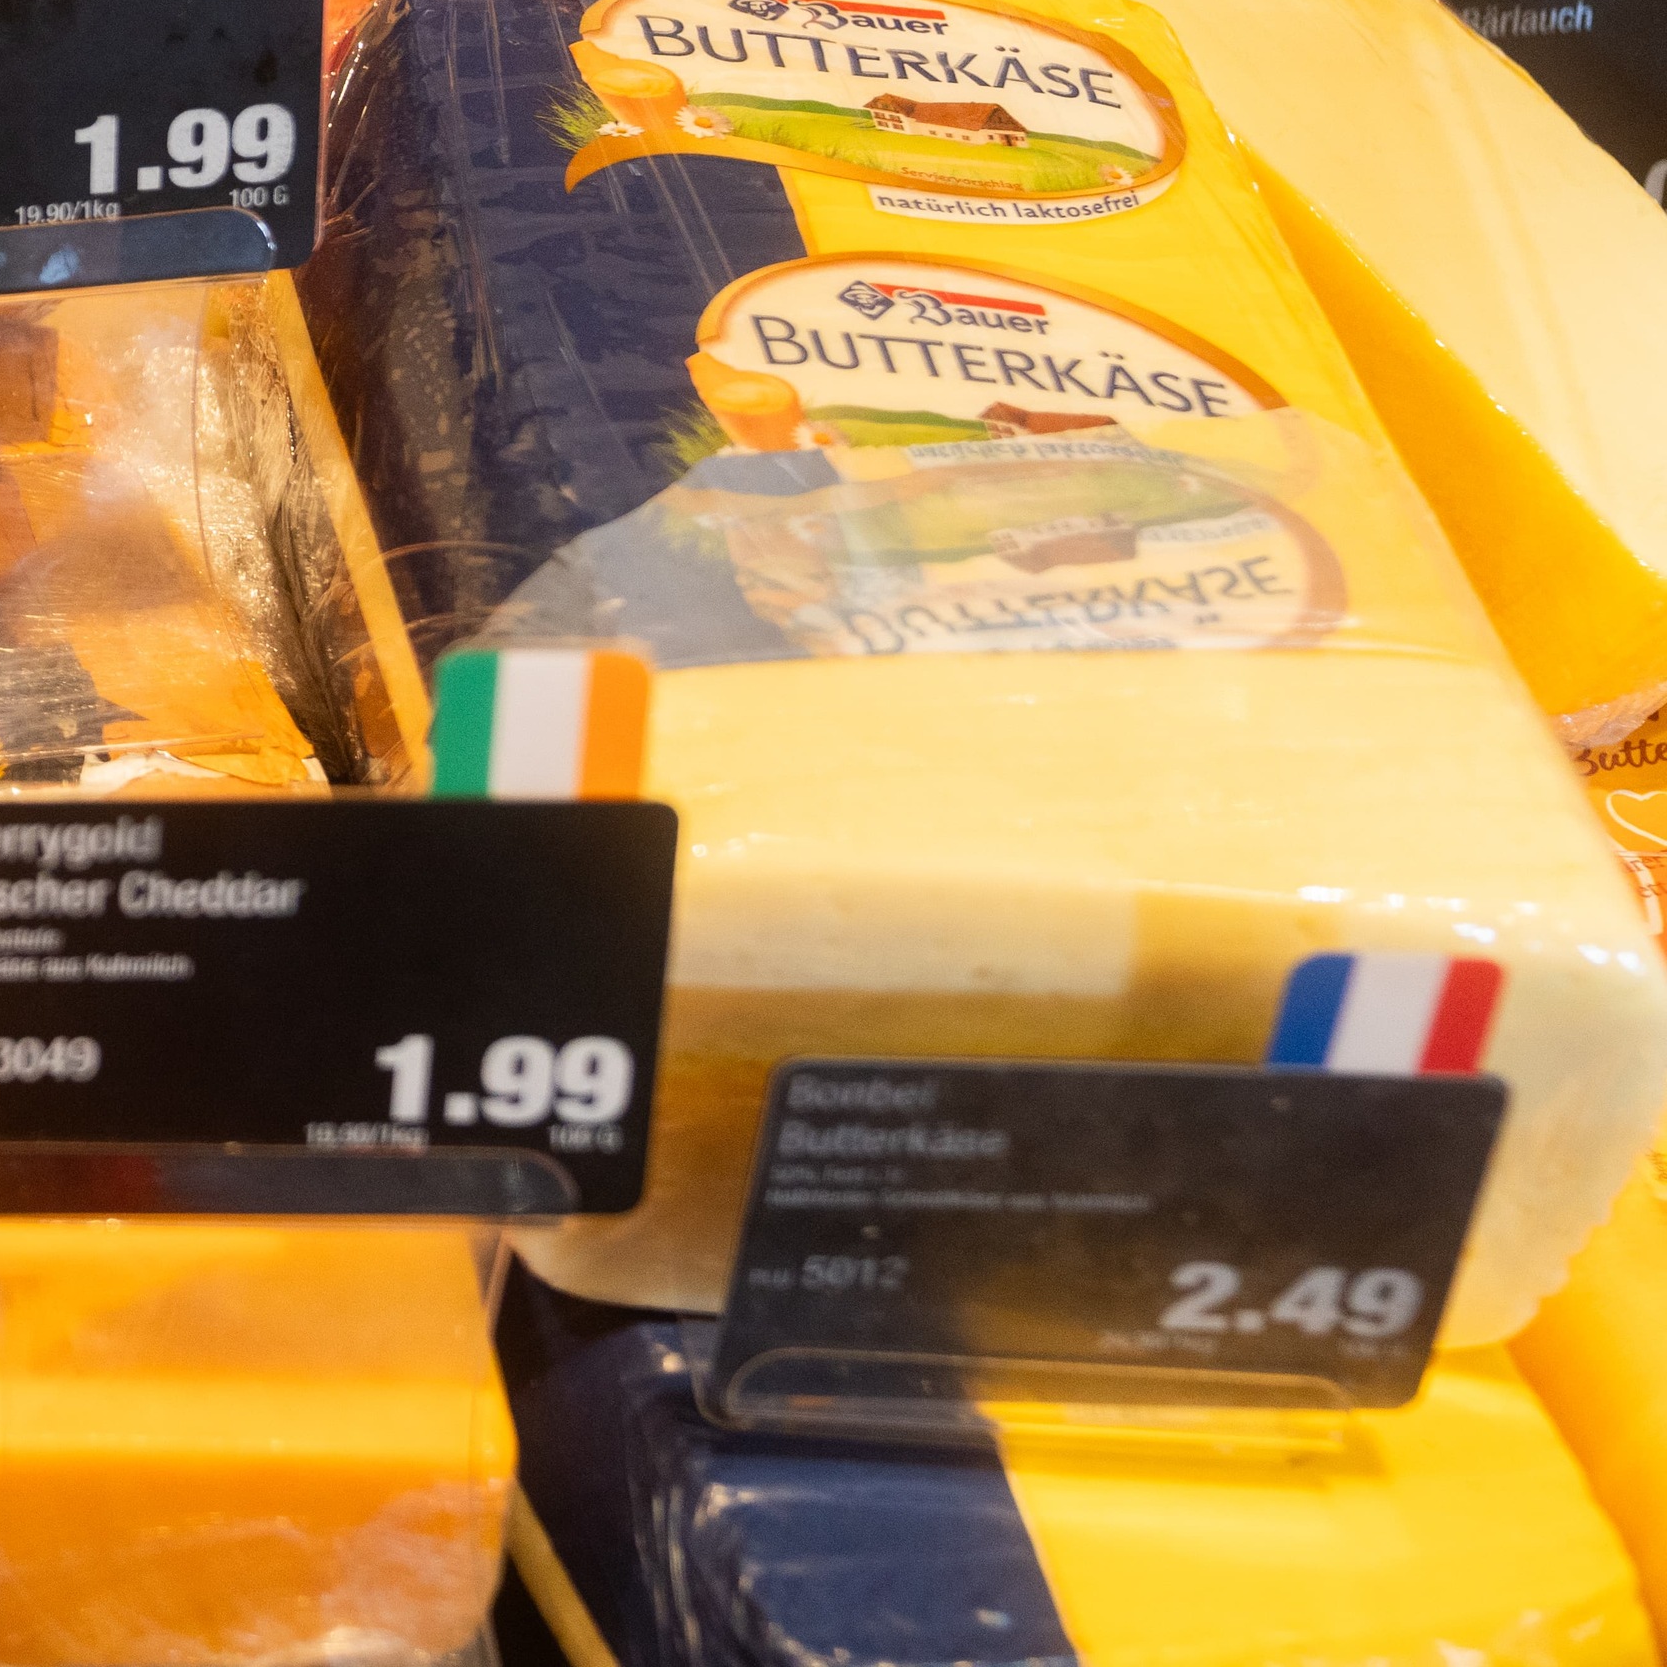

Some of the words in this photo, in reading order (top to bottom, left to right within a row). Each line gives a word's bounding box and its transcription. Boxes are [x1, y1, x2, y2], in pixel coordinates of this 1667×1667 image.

[634, 13, 1124, 111] BUTTERKÄSE
[74, 103, 297, 196] 1.99
[899, 164, 1026, 193] Serviervorschlag
[15, 199, 122, 227] 19.90/1kg
[230, 185, 268, 210] 100
[272, 183, 290, 207] G
[877, 189, 1008, 220] natürlich
[1011, 188, 1141, 222] laktosefrei
[901, 288, 1052, 338] Bauer
[748, 313, 1240, 421] BUTTERKÄSE
[117, 870, 307, 919] Cheddar
[374, 1033, 637, 1128] 1.99
[778, 1120, 1010, 1160] Butterkäse
[1158, 1259, 1422, 1335] 2.49
